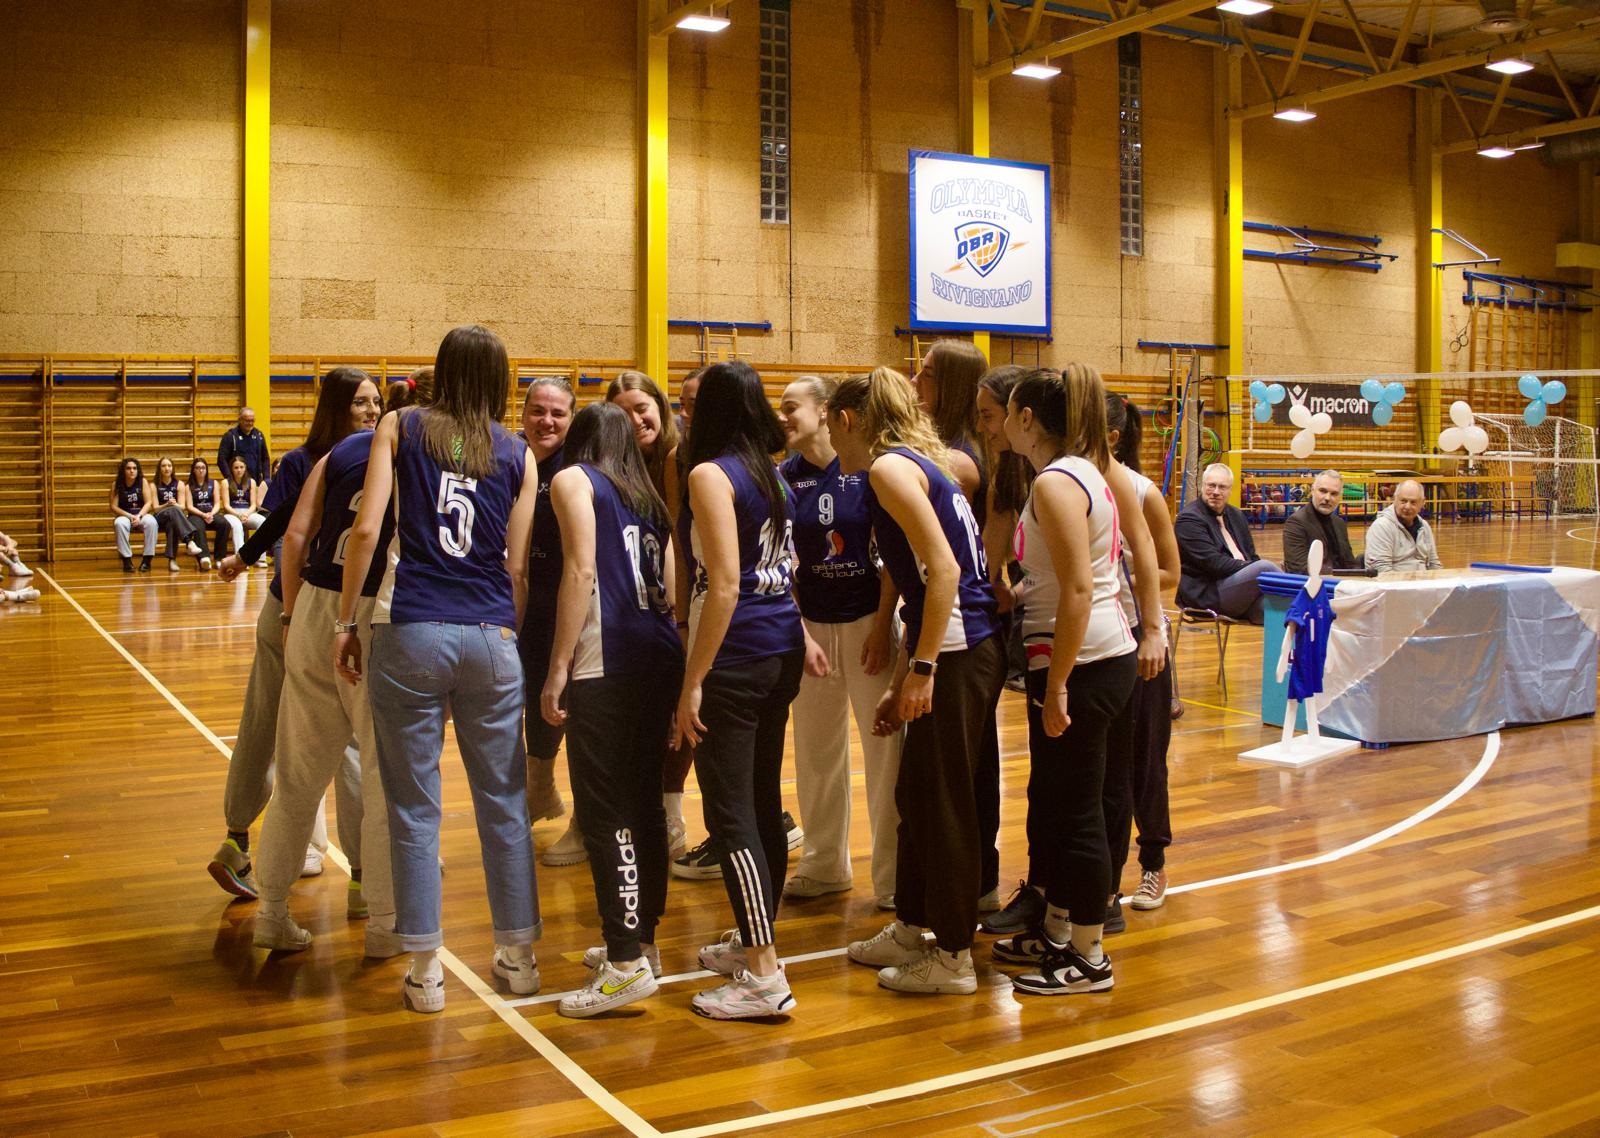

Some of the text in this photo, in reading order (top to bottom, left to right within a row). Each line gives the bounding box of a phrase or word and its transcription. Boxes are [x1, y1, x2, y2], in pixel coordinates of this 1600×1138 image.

[930, 177, 1033, 223] OLYMPIA
[957, 208, 1008, 222] BASKET
[957, 231, 994, 260] OBR
[930, 272, 1033, 308] RIVIGNANO
[1310, 397, 1369, 414] macron
[436, 470, 478, 558] 5
[818, 493, 834, 526] 9
[753, 517, 792, 596] 16
[615, 827, 640, 930] adidas
